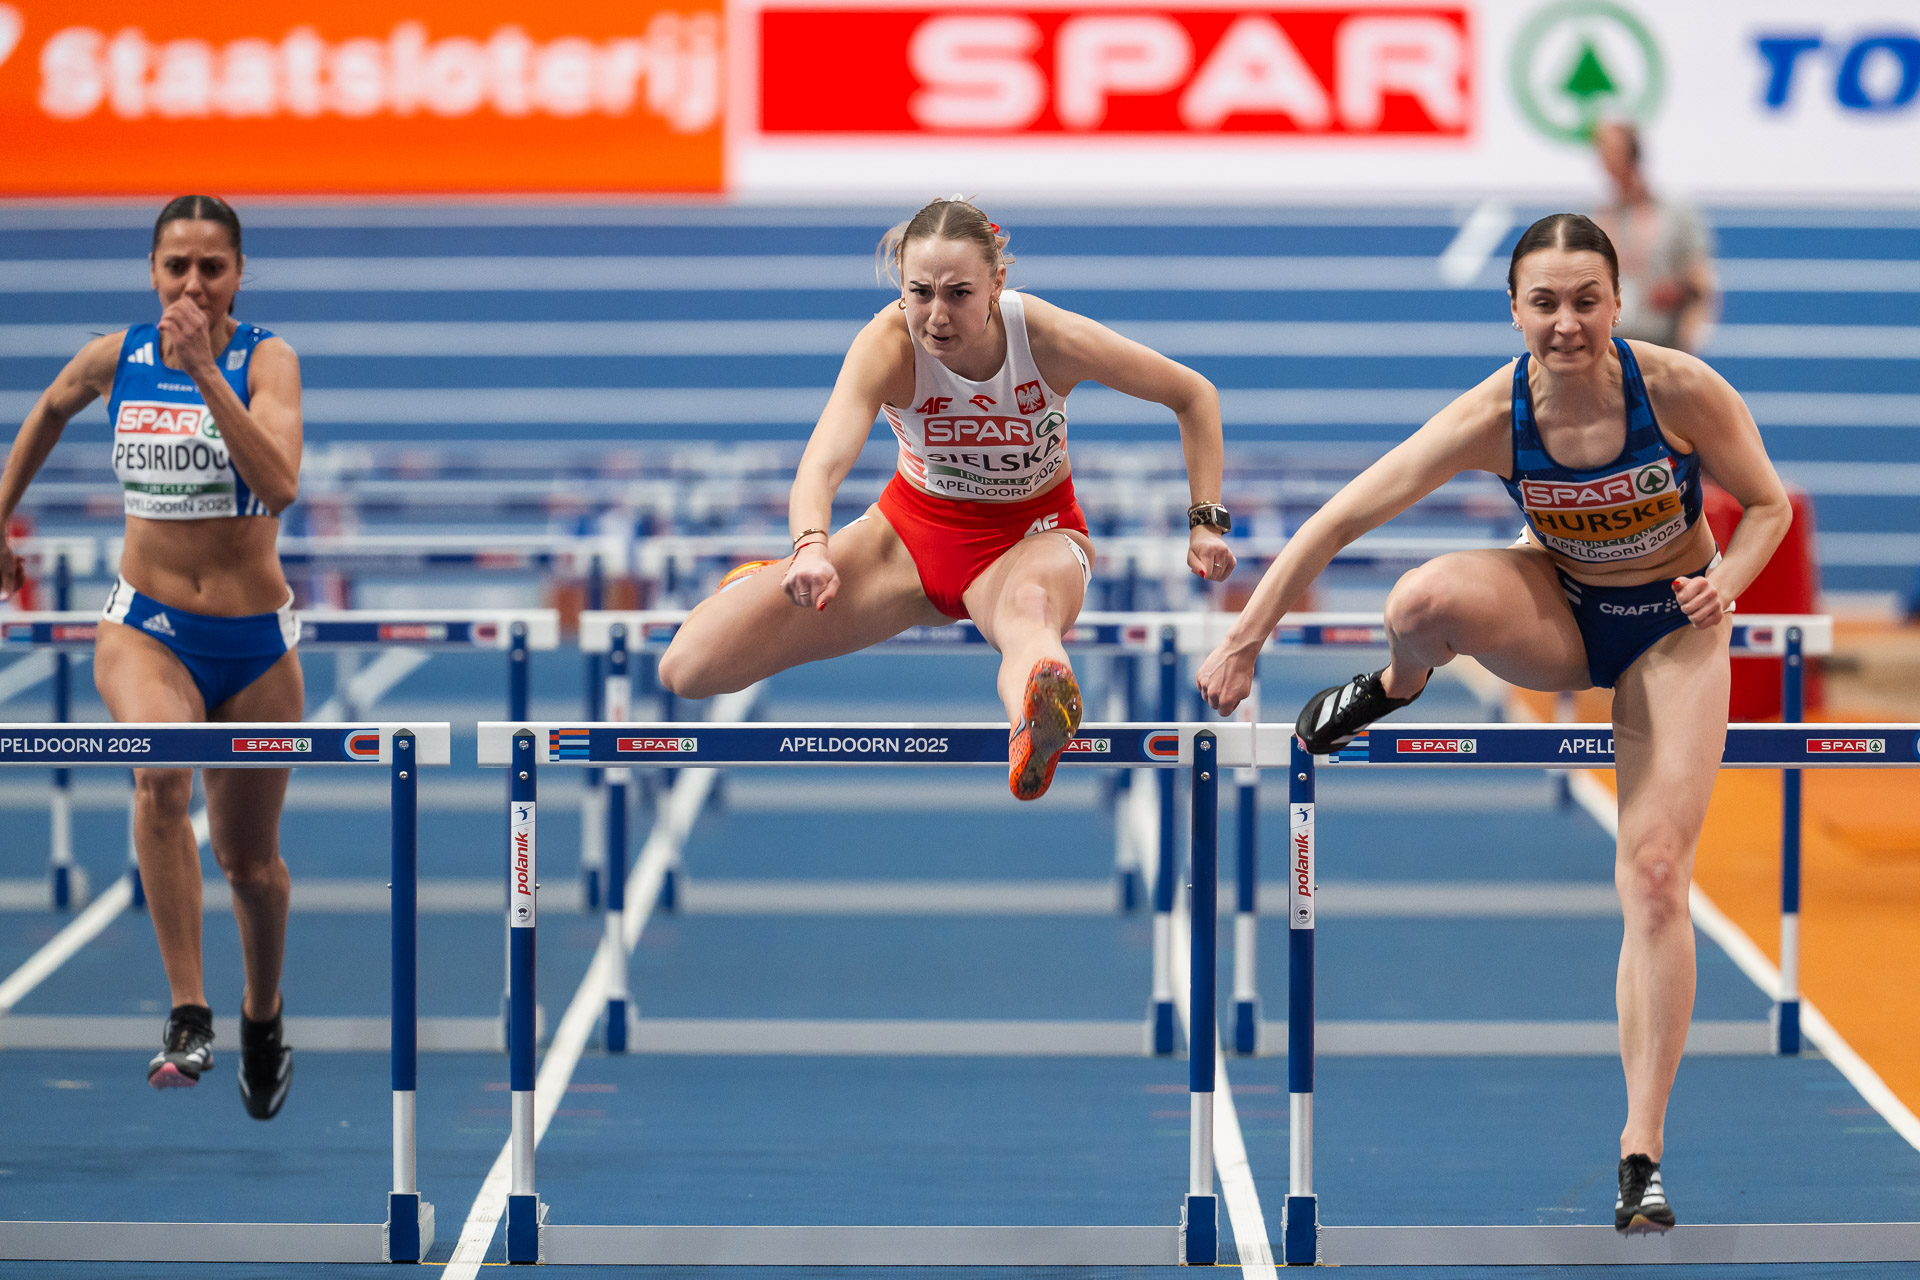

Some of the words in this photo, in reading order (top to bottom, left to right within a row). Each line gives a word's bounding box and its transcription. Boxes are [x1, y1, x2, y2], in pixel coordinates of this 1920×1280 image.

[38, 12, 718, 134] Staatsloterij
[906, 14, 1466, 129] SPAR
[1754, 34, 1920, 111] TO
[119, 408, 198, 433] SPAR
[927, 419, 1031, 443] SPAR
[115, 443, 227, 471] PESIRIDOU
[927, 433, 1061, 472] SIELSKA
[936, 479, 1033, 497] APELDOORN
[1033, 456, 1062, 486] 2025
[966, 472, 995, 485] RUN
[997, 477, 1032, 486] CLEA
[1526, 479, 1632, 505] SPAR
[1532, 497, 1676, 533] HURSKE
[1551, 537, 1646, 559] APELDOORN
[1650, 521, 1682, 548] 2025
[1599, 602, 1663, 616] CRAFT
[0, 737, 103, 753] PELDOORN
[108, 737, 151, 753] 2025
[246, 740, 292, 750] SPAR
[632, 740, 678, 750] SPAR
[779, 737, 900, 752] APELDOORN
[904, 737, 949, 752] 2025
[1067, 740, 1091, 750] AR
[1411, 741, 1457, 751] SPAR
[1558, 738, 1615, 754] APELD
[1821, 741, 1866, 751] SPAR
[514, 831, 532, 896] polanik
[1294, 833, 1312, 897] polanik
